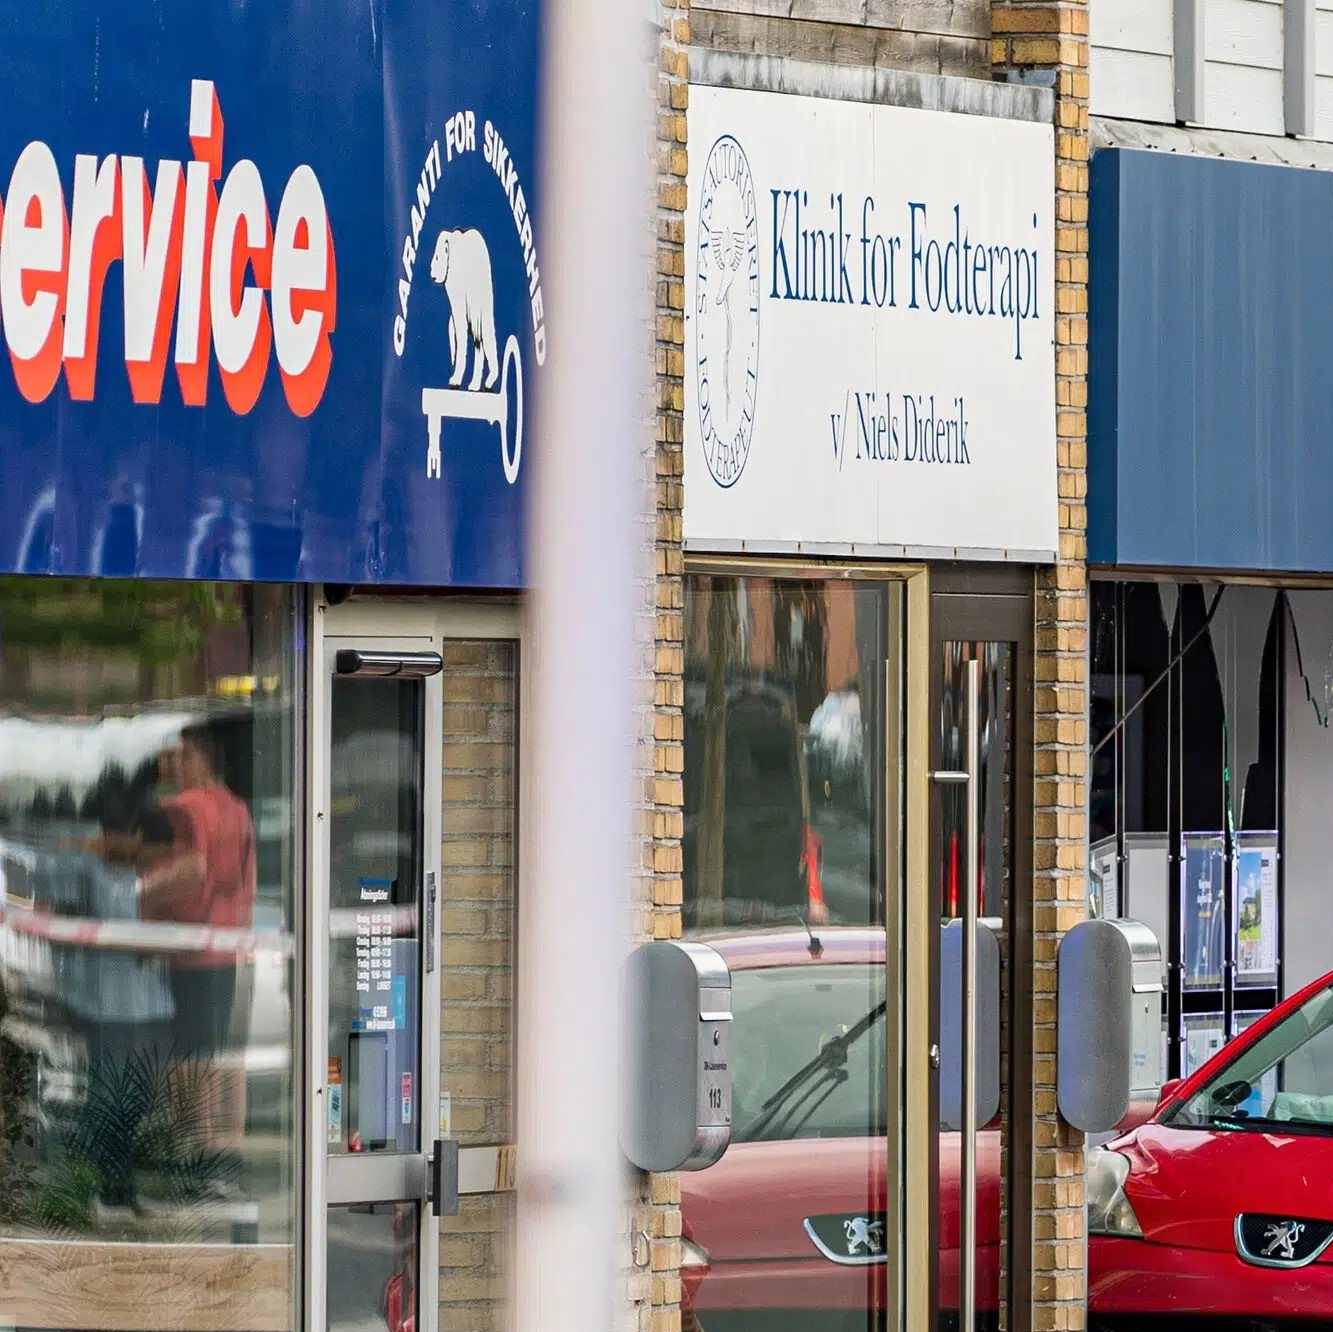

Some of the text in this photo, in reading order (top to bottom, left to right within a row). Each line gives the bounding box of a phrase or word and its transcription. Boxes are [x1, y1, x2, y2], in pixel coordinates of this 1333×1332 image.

[0, 79, 336, 416] ervice
[393, 110, 547, 366] GARANTI FOR SIKKERHED
[769, 188, 1040, 360] Klinik for Fodterapi
[854, 392, 899, 462] Niels
[902, 394, 971, 464] Diderik
[709, 1088, 721, 1109] 113
